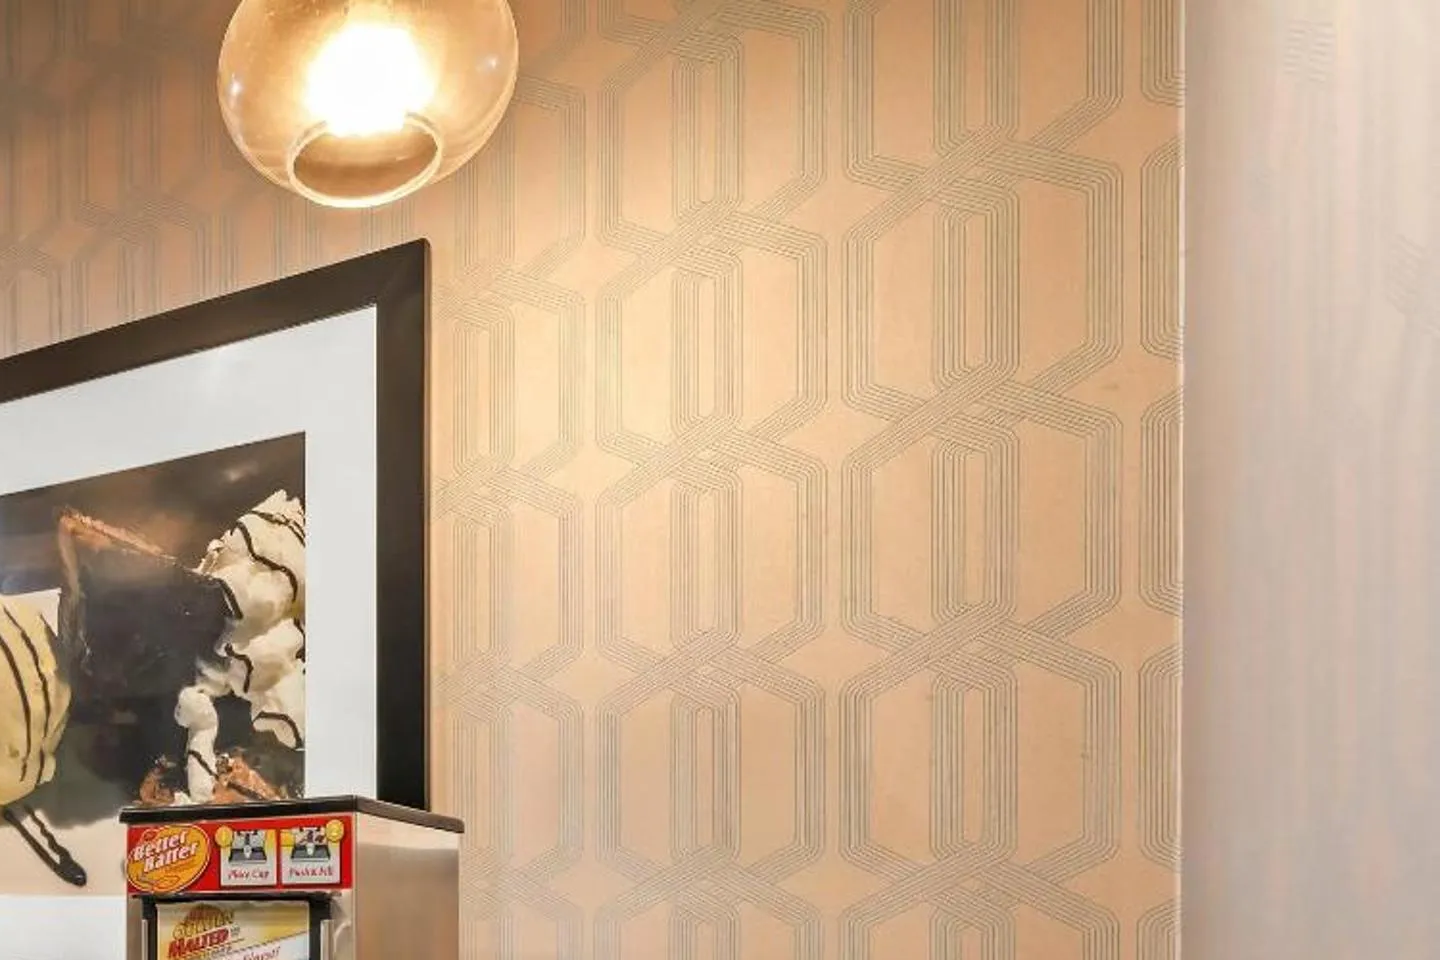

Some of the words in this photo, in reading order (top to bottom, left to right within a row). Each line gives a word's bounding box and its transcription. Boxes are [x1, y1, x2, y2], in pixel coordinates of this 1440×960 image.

[133, 829, 188, 861] Better
[143, 842, 198, 873] Batter
[168, 927, 229, 960] MALTED
